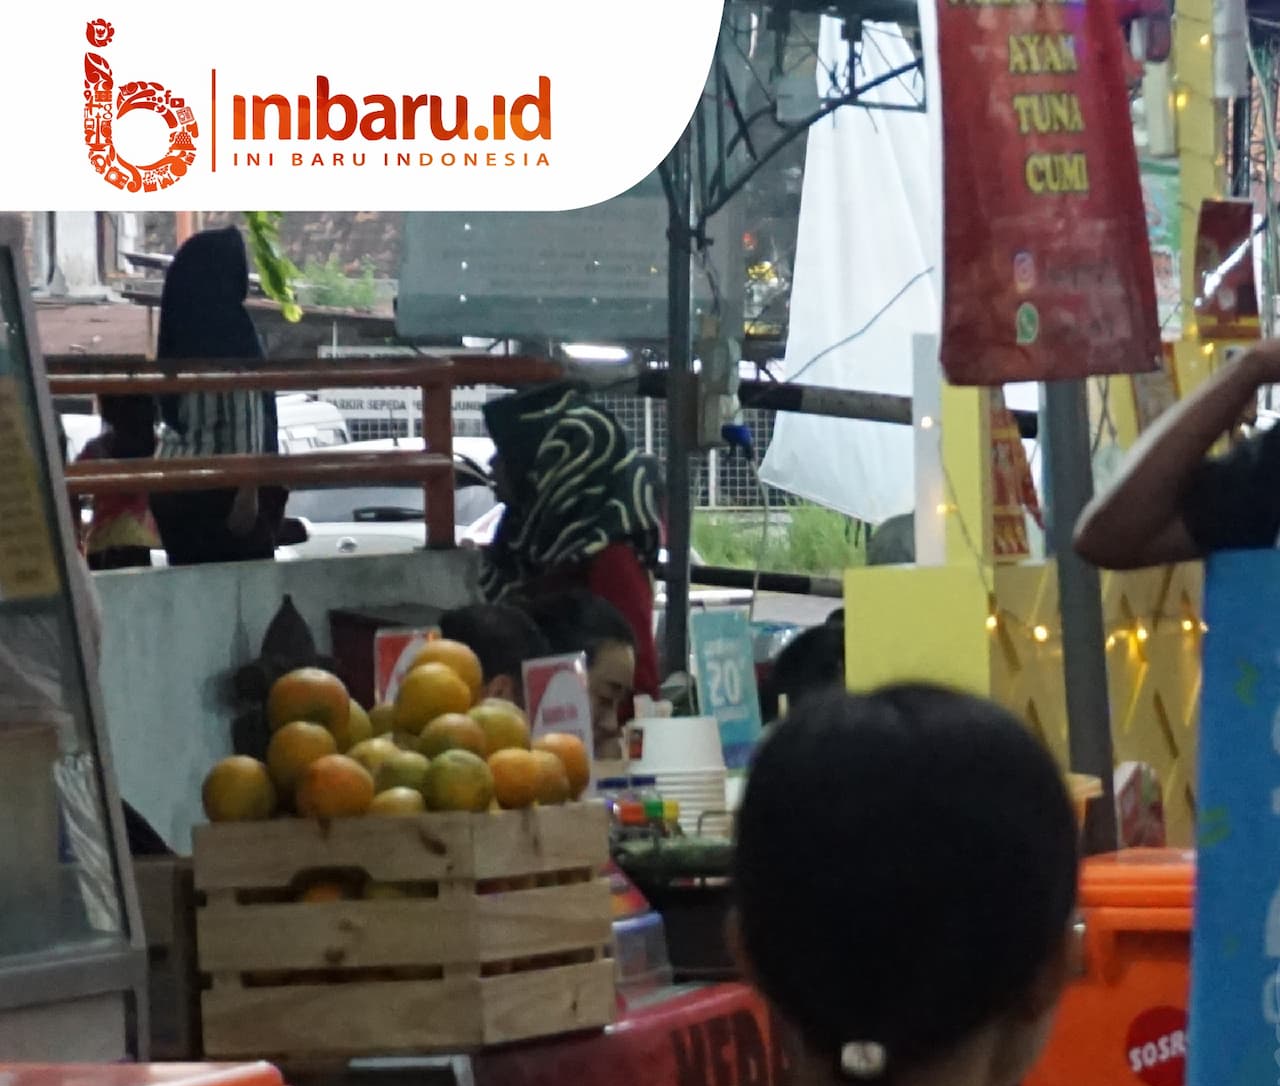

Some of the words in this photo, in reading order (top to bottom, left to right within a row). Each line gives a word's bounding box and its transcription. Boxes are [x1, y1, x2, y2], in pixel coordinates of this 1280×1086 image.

[1014, 94, 1084, 133] TUNA
[1025, 153, 1089, 193] CUMI
[1129, 1029, 1189, 1074] SOSR
